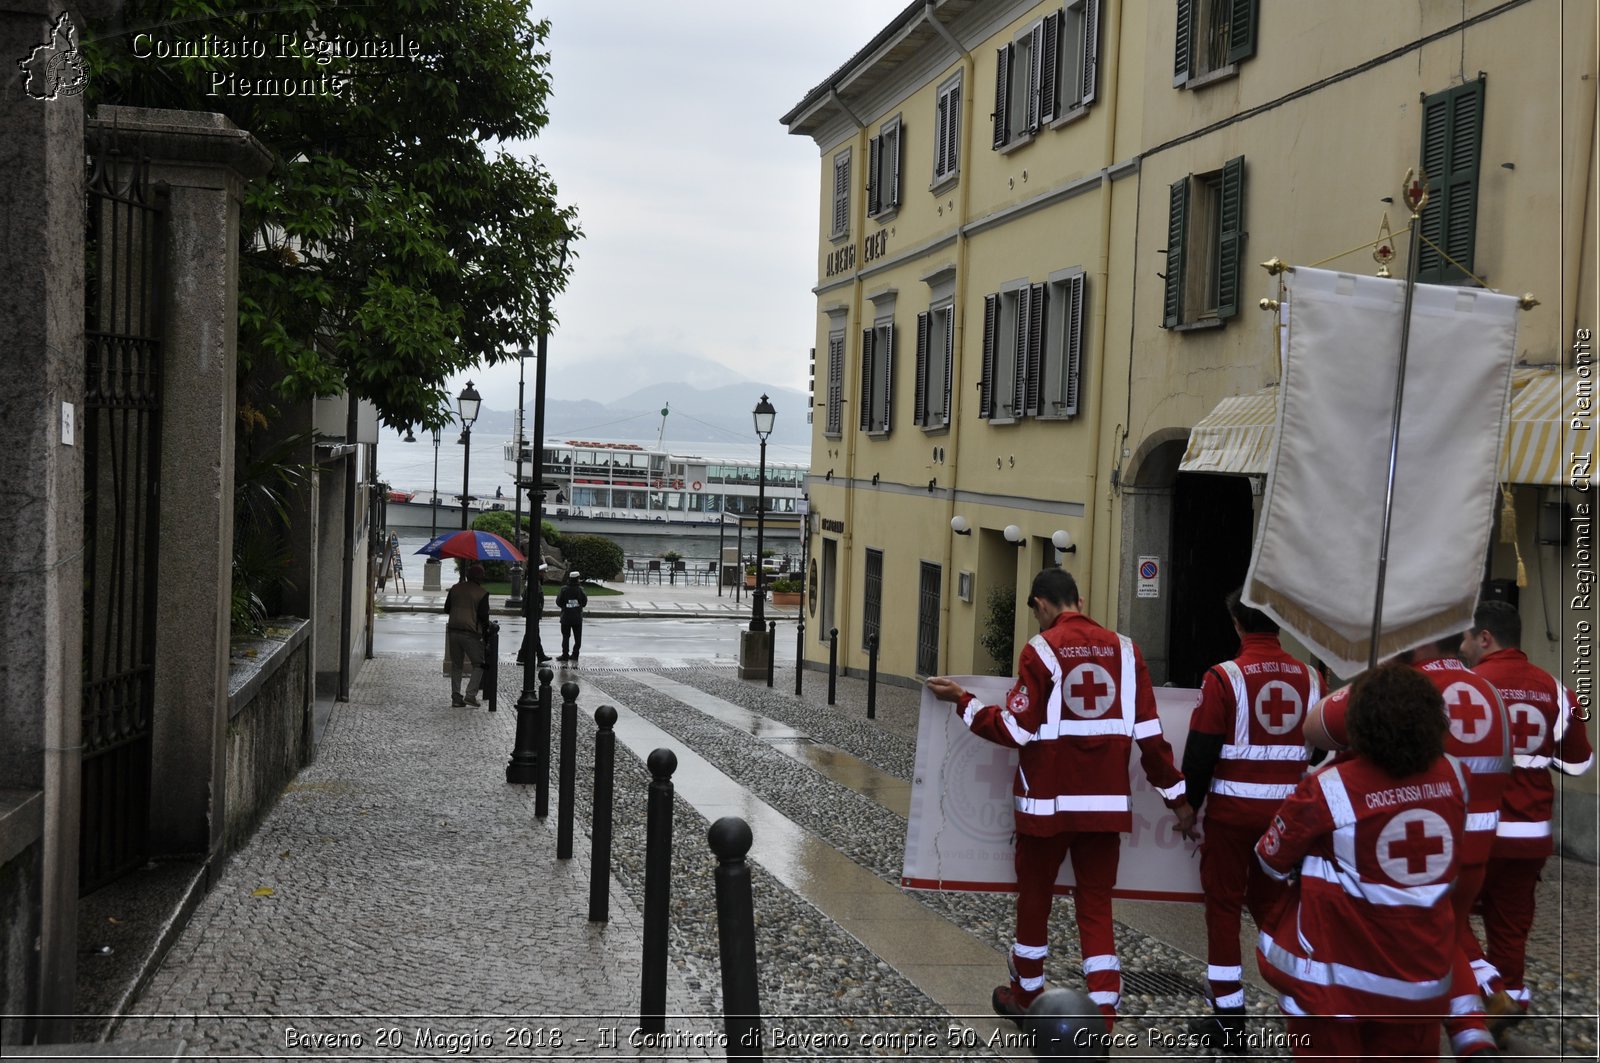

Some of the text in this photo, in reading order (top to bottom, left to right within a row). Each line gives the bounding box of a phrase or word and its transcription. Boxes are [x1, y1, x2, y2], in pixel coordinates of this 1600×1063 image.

[1092, 645, 1114, 657] ITALIANA
[1243, 662, 1262, 675] CROCE
[1261, 661, 1280, 673] ROSSA
[1508, 689, 1528, 700] ROSSA
[1527, 690, 1551, 703] ITALIANA
[1365, 781, 1454, 809] CROCE ROSSA ITALIANA
